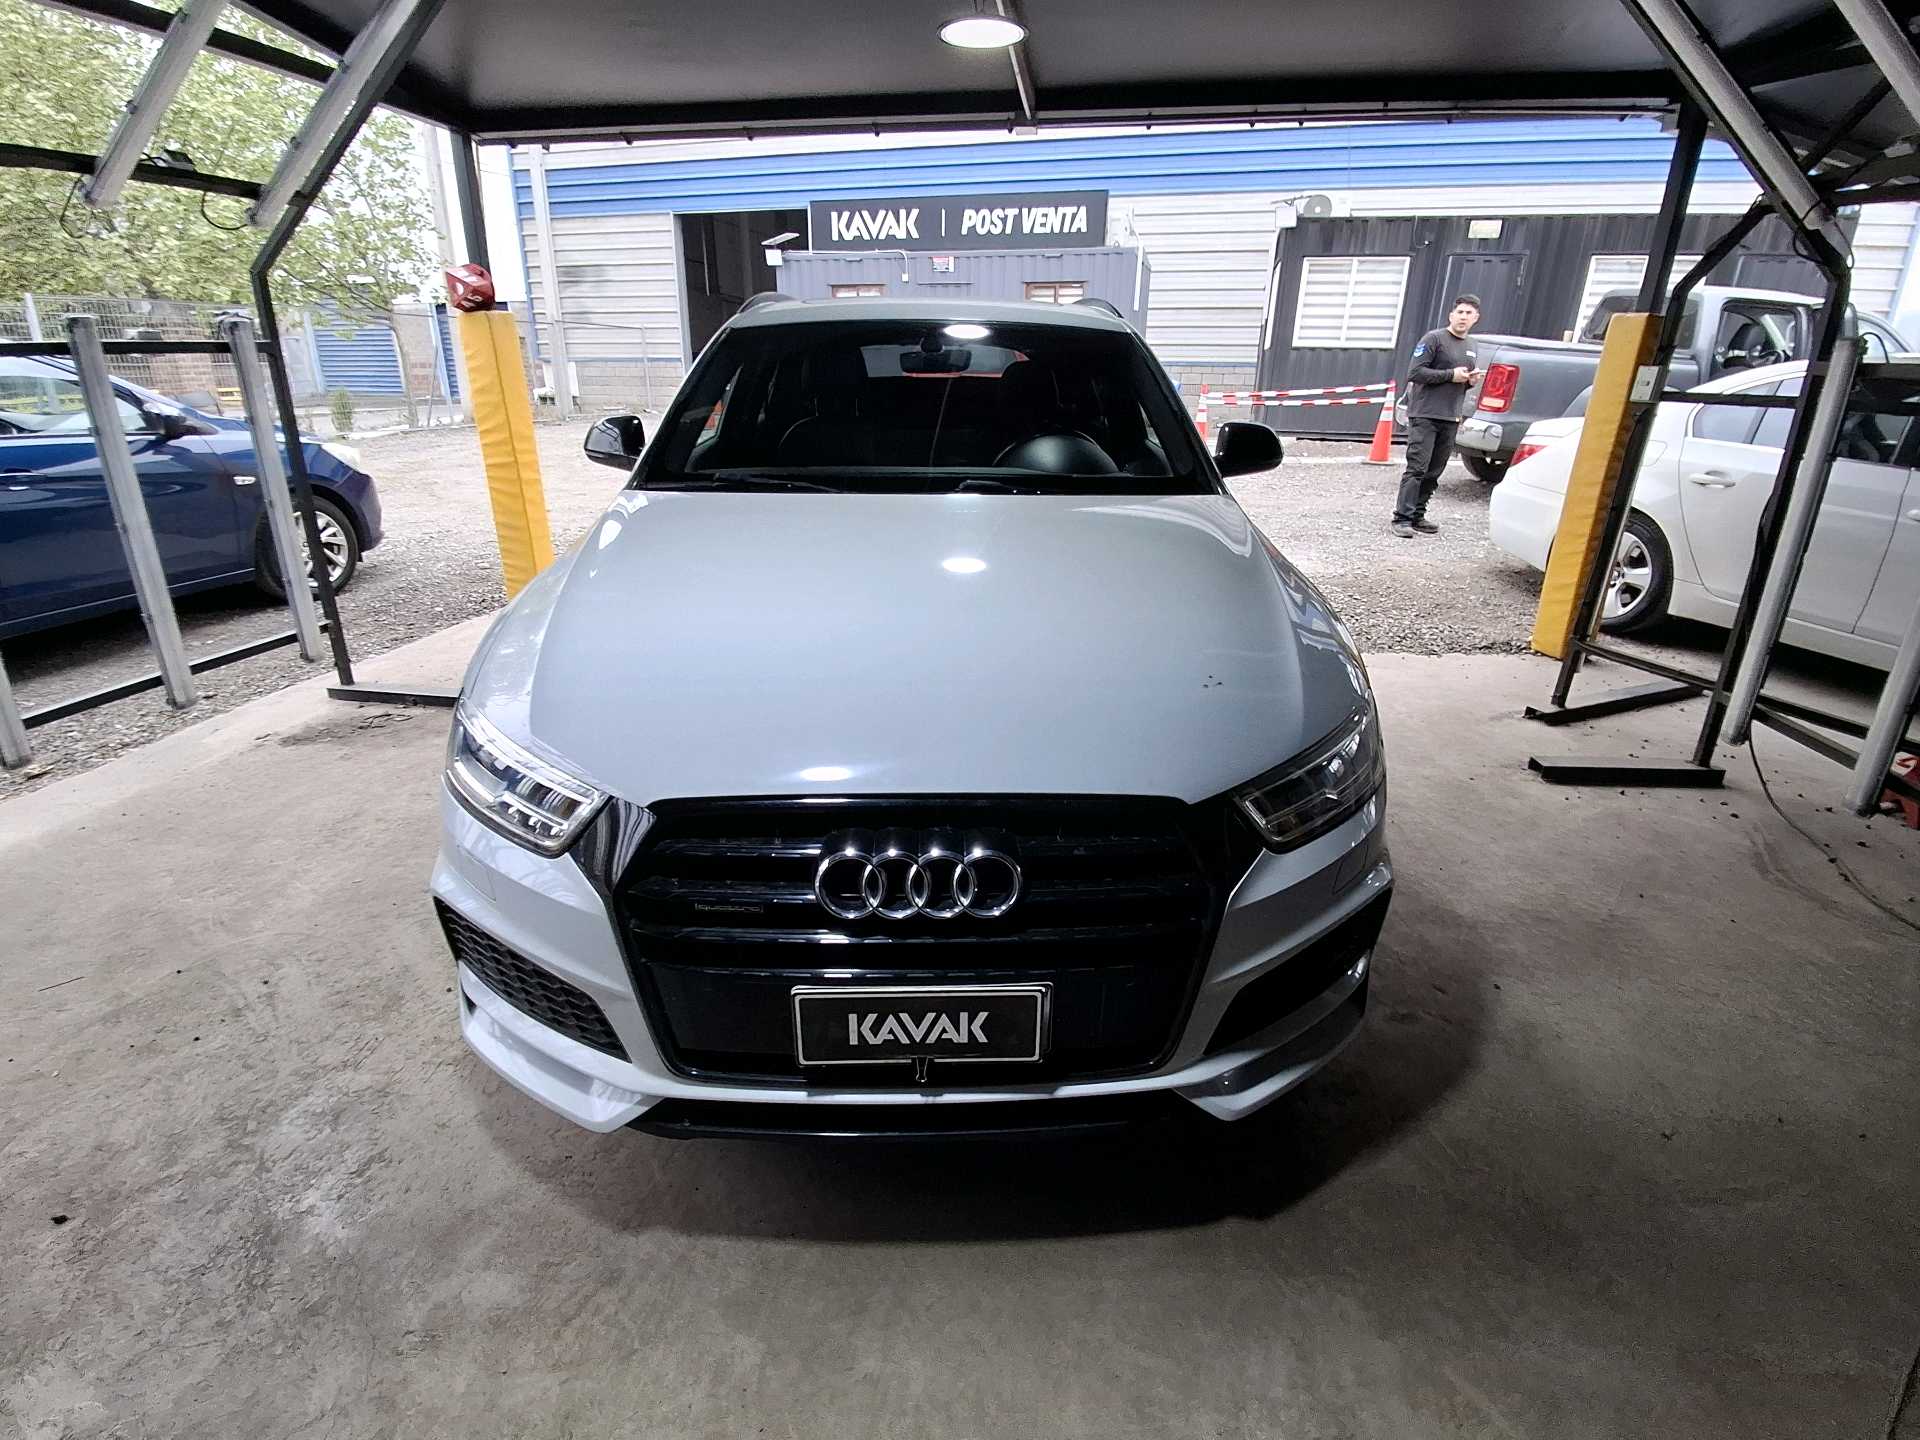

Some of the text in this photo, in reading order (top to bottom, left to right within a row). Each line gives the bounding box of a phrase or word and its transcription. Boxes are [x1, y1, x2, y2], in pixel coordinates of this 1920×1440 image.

[831, 206, 1087, 241] KAVAK POST VENTA
[848, 1011, 989, 1046] KAVAK
